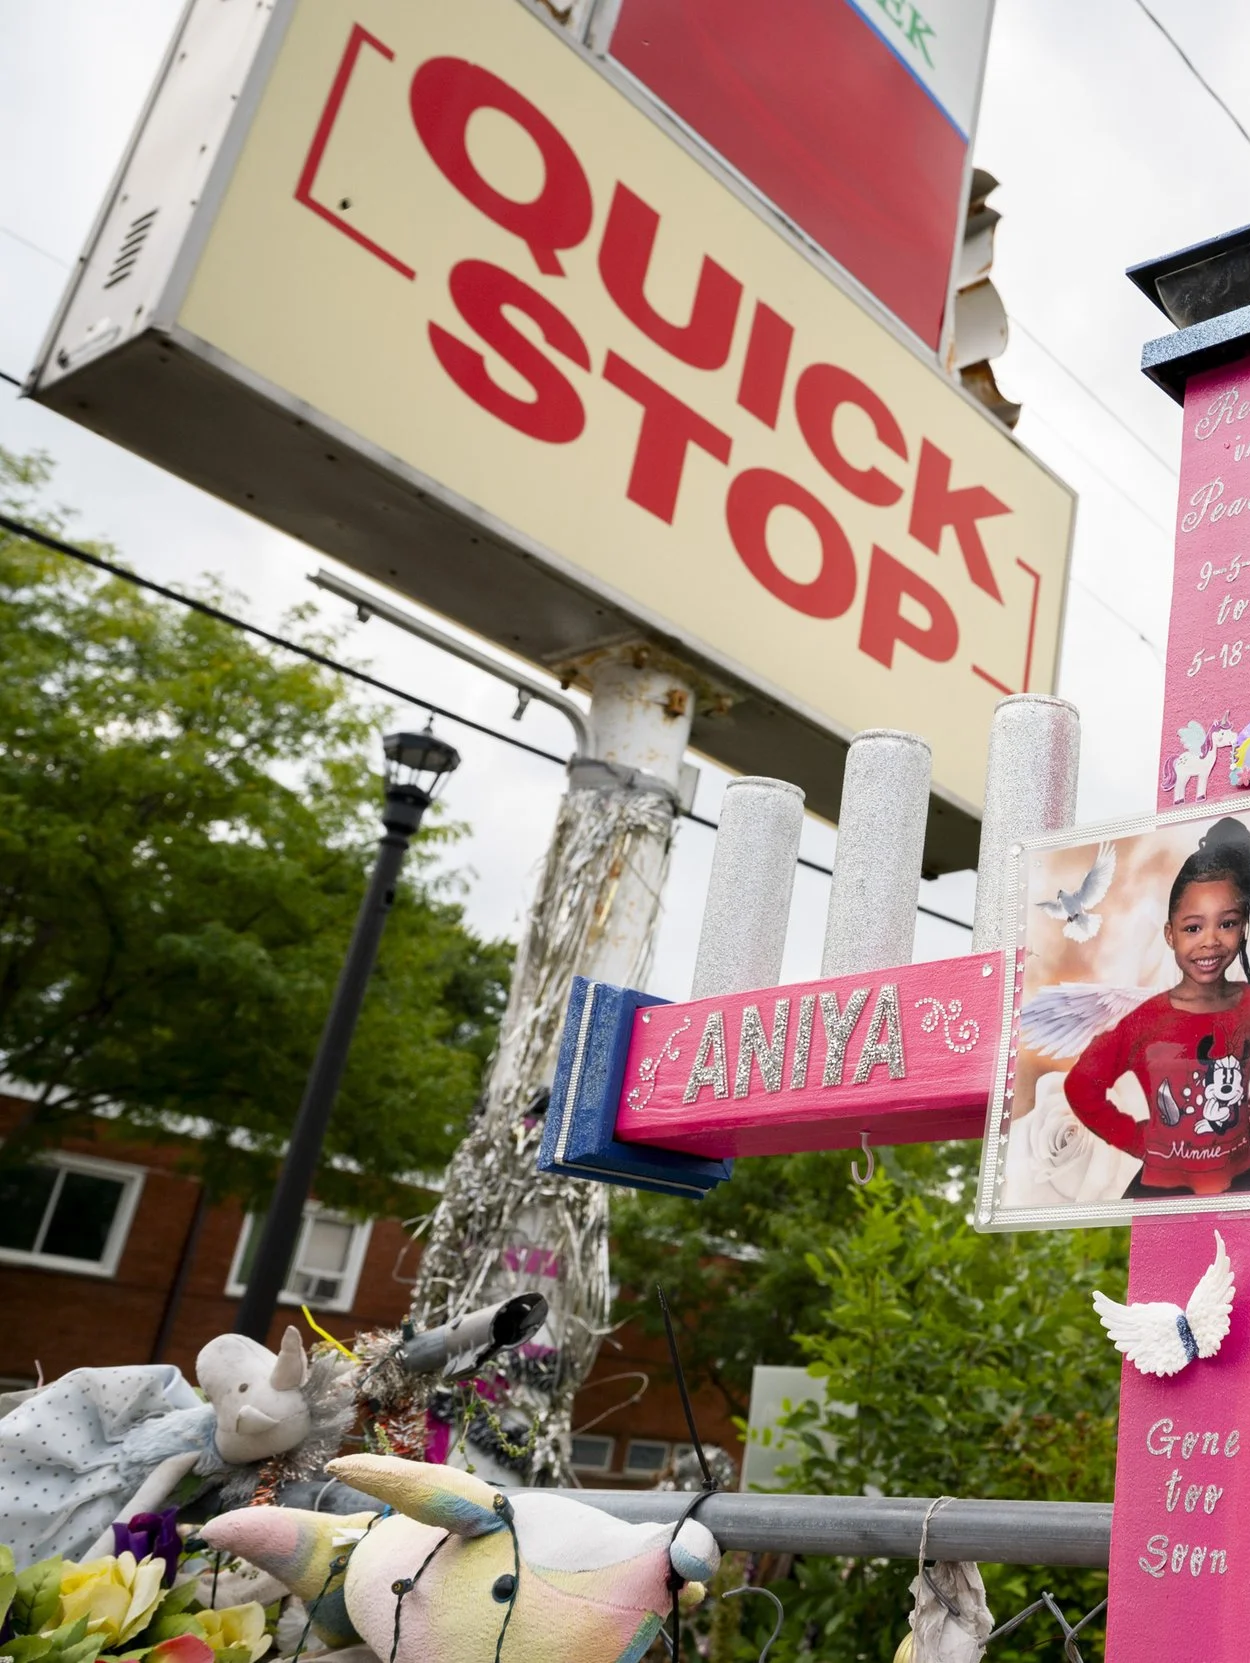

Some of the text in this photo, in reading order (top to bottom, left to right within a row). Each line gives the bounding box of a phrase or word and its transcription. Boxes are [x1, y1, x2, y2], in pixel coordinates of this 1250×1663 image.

[409, 54, 1013, 607] QUICK
[427, 258, 960, 670] STOP
[1216, 593, 1249, 625] to
[681, 983, 907, 1105] ANIYA
[1163, 1140, 1229, 1161] Minnie
[1146, 1417, 1241, 1461] Gone
[1163, 1468, 1224, 1515] too
[1137, 1533, 1229, 1579] Soon
